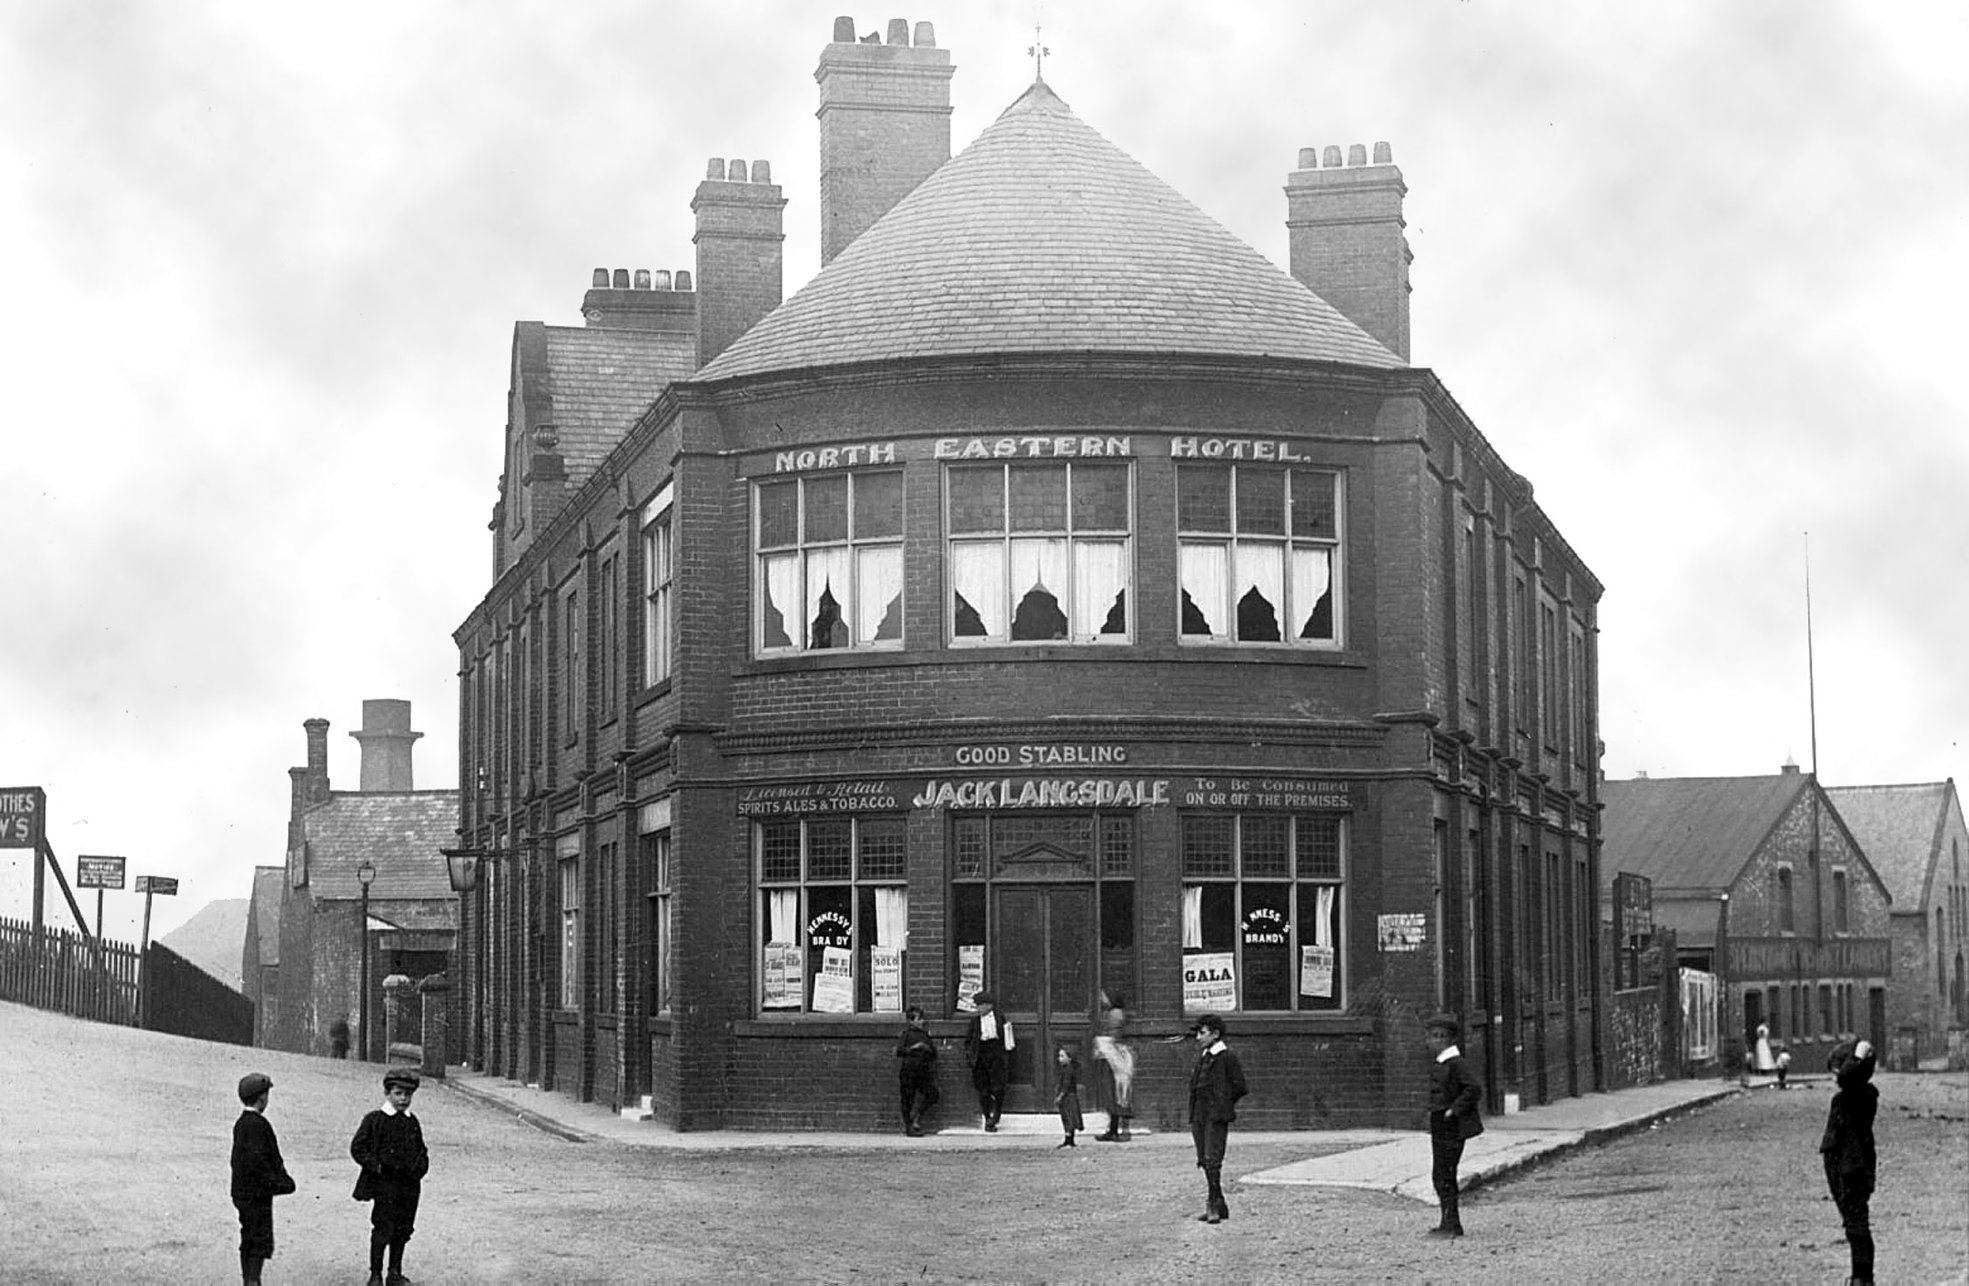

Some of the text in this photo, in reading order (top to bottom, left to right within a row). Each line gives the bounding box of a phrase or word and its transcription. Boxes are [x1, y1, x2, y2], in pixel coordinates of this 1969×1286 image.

[775, 436, 1312, 472] NORTH EASTERN HOTEL.
[956, 745, 1126, 764] GOOD STABLING
[912, 778, 1171, 808] JACK LANGSDALE
[1195, 777, 1349, 793] To Be Consumed
[0, 793, 35, 813] THES
[738, 796, 899, 815] SPIRITS ALES & TOBACCO.
[1186, 792, 1353, 808] ON OR OFF THE PREMISES.
[812, 936, 849, 946] BRADY
[1185, 968, 1232, 982] GALA
